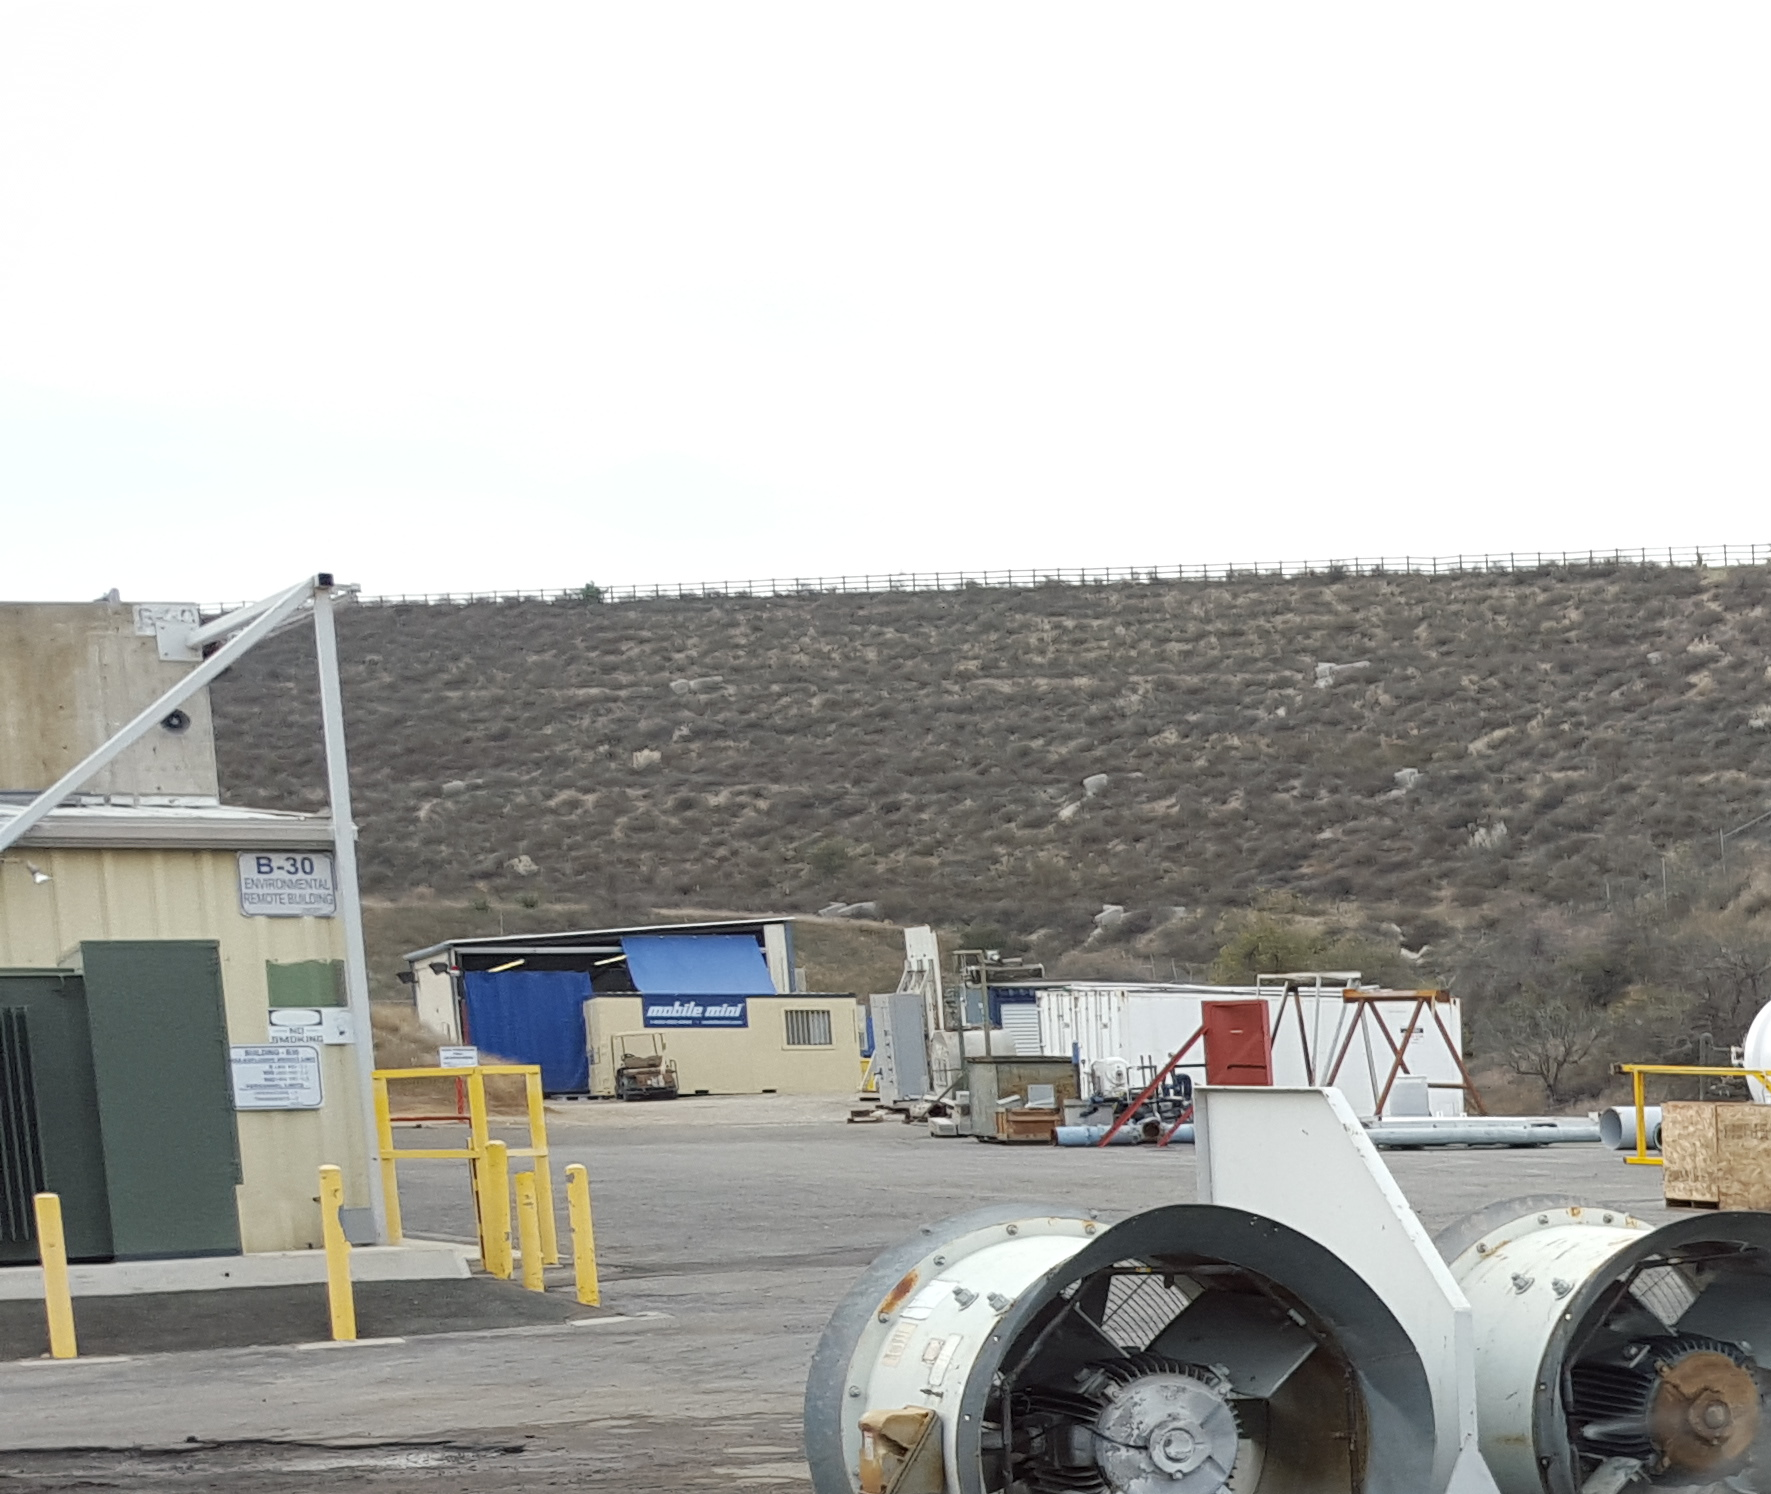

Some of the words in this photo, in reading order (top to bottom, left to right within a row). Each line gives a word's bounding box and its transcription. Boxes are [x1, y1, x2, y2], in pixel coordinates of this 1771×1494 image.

[255, 856, 314, 876] B-30
[244, 877, 330, 890] ENVIRONMENTAL
[243, 892, 286, 905] REMOTE
[287, 893, 333, 905] BUILDING
